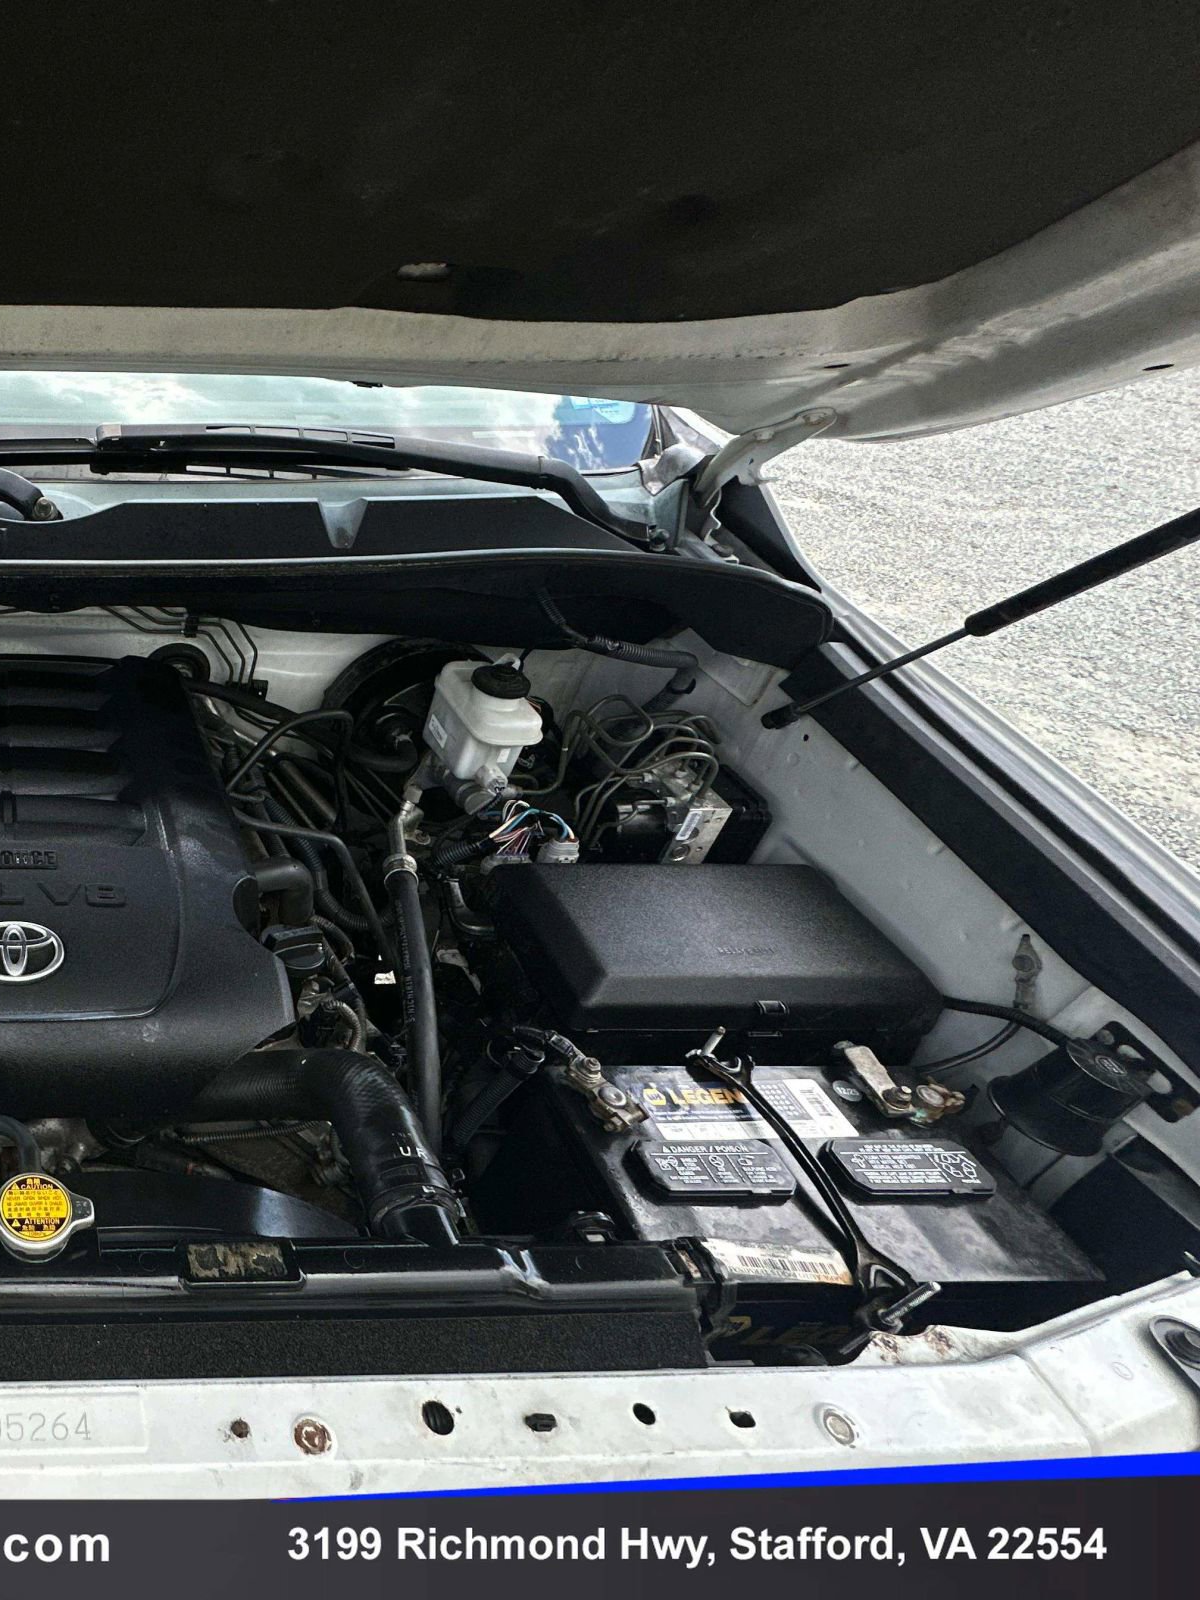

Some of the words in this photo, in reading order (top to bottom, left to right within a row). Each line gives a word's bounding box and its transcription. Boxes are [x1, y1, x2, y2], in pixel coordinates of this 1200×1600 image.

[36, 882, 127, 907] V8
[666, 1087, 746, 1105] LEGEN
[670, 1145, 707, 1153] DANGER
[716, 1144, 749, 1153] POISON
